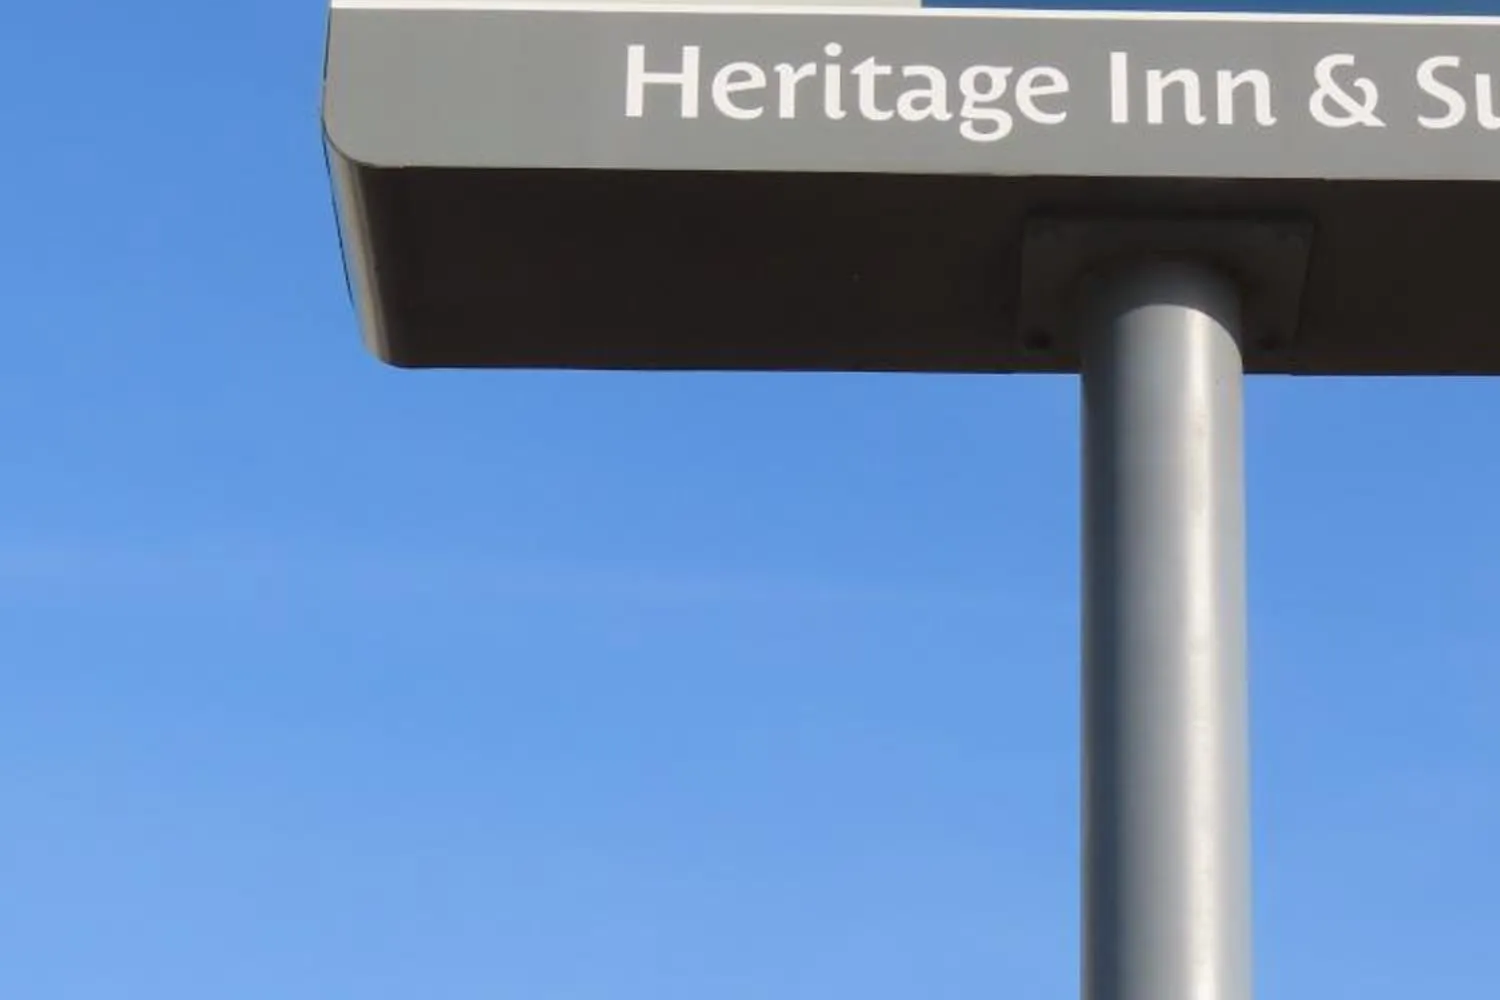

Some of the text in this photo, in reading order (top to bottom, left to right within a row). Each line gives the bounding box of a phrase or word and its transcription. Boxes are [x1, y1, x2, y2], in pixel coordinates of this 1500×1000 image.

[624, 43, 1069, 142] Heritage
[1110, 51, 1277, 126] Inn
[1308, 53, 1386, 129] &
